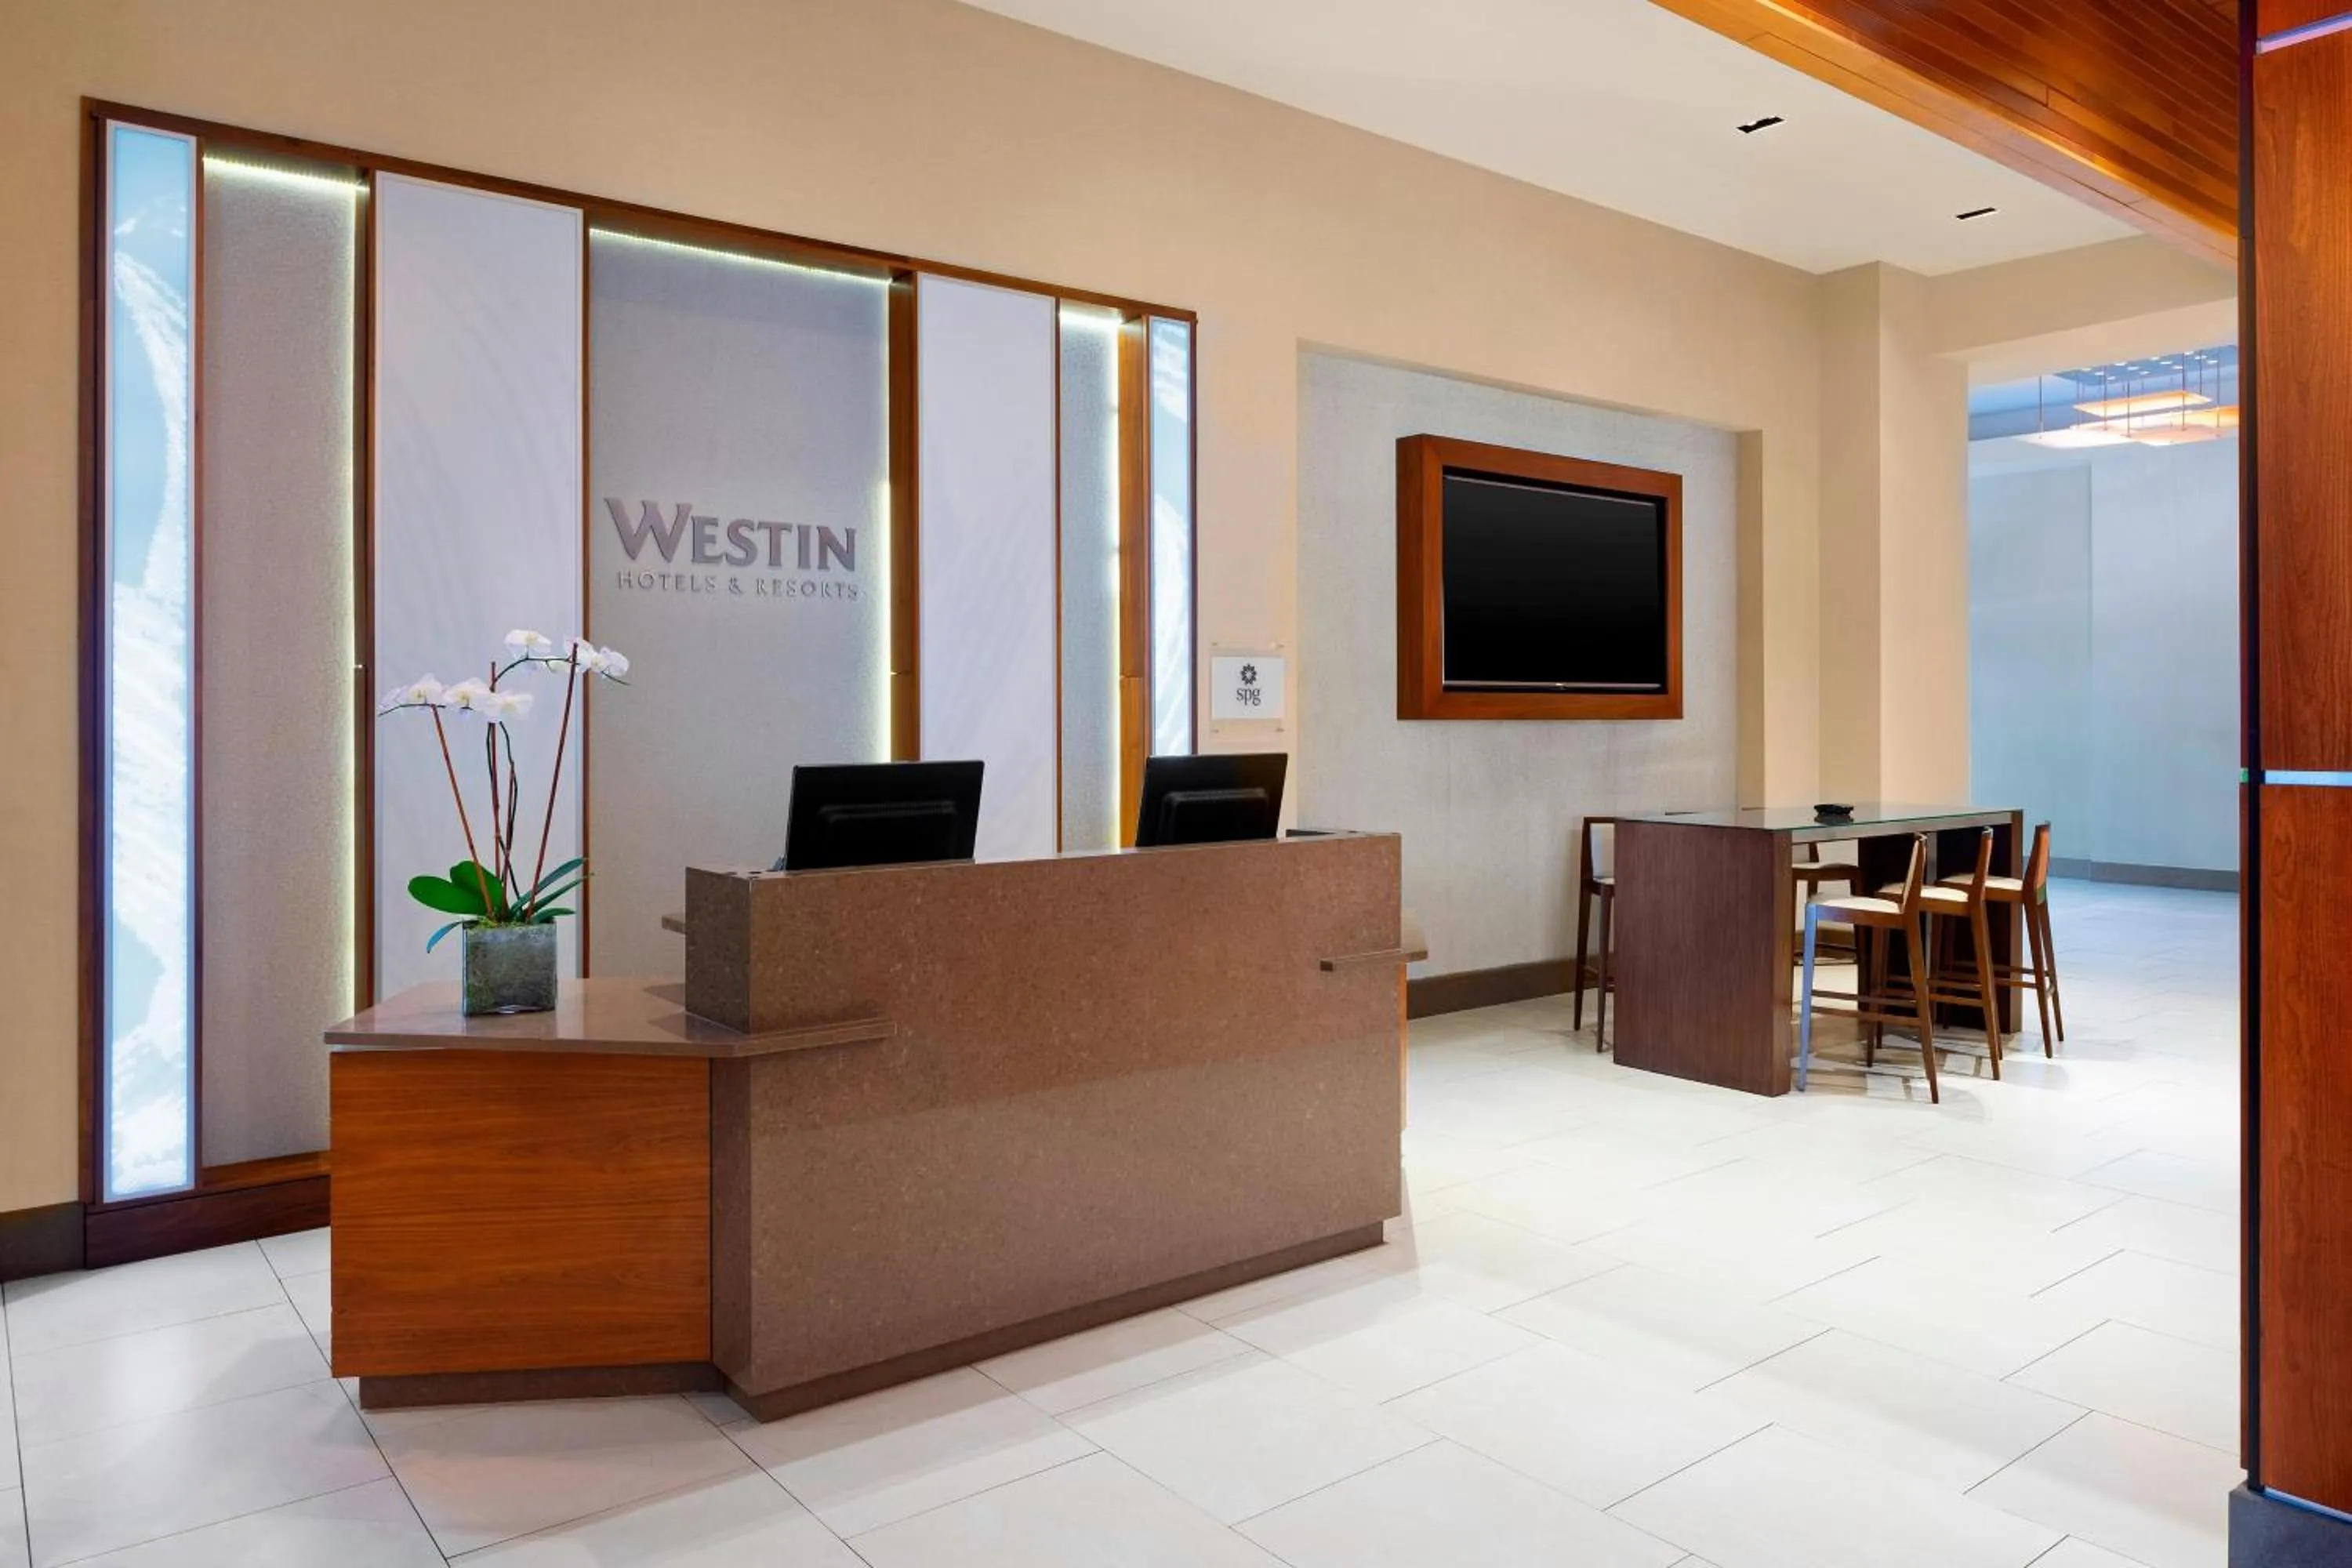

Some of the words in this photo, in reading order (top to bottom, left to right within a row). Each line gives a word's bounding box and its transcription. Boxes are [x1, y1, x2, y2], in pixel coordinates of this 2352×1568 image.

[604, 498, 857, 572] WESTIN
[618, 572, 717, 593] HOTELS
[728, 579, 744, 595] &
[756, 579, 858, 601] RESORTS
[1236, 688, 1261, 706] spg
